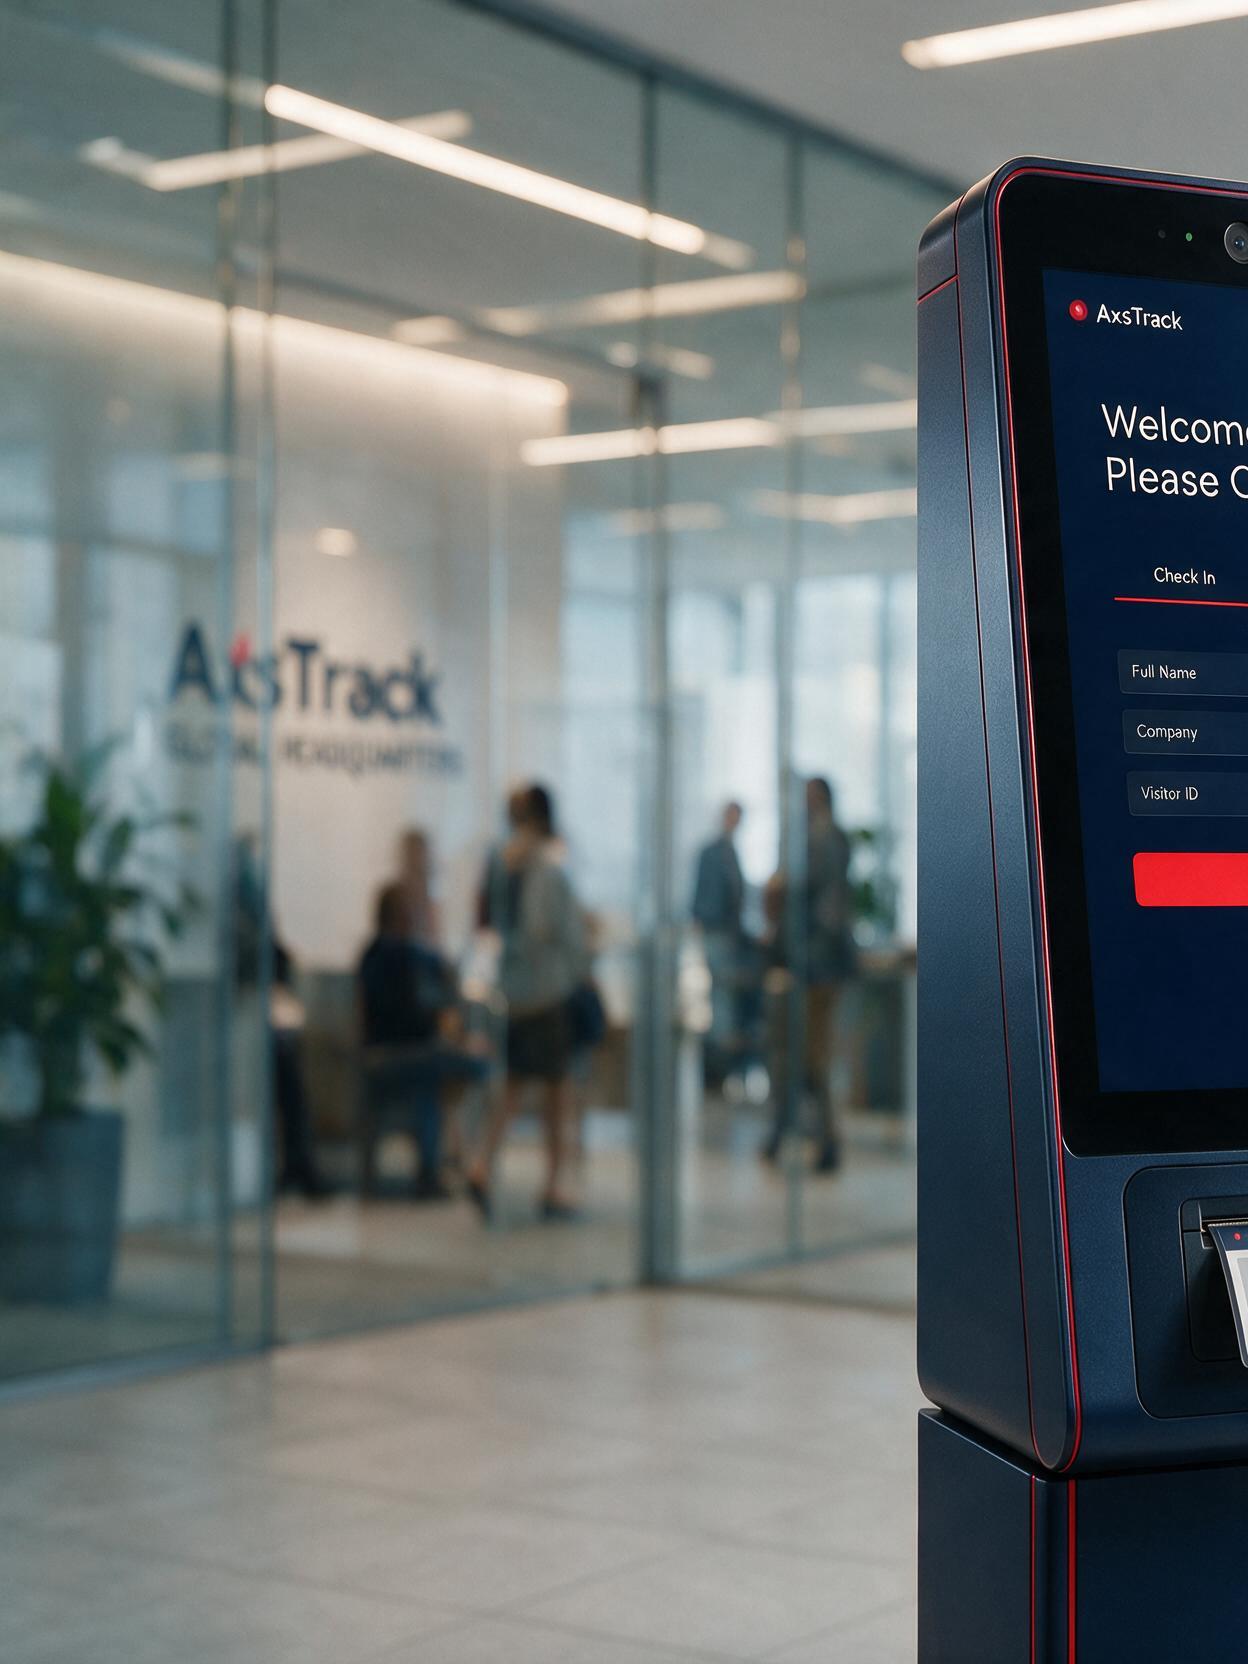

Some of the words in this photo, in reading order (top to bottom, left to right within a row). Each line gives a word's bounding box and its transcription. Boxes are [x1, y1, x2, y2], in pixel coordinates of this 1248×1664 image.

[1096, 303, 1184, 331] AxsTrack
[1106, 456, 1219, 498] Please
[1153, 566, 1199, 586] Check
[1203, 569, 1216, 586] In
[1131, 663, 1155, 679] Full
[1159, 664, 1198, 681] Name
[1136, 723, 1198, 743] Company
[1140, 785, 1182, 802] Visitor
[1185, 786, 1200, 802] ID
